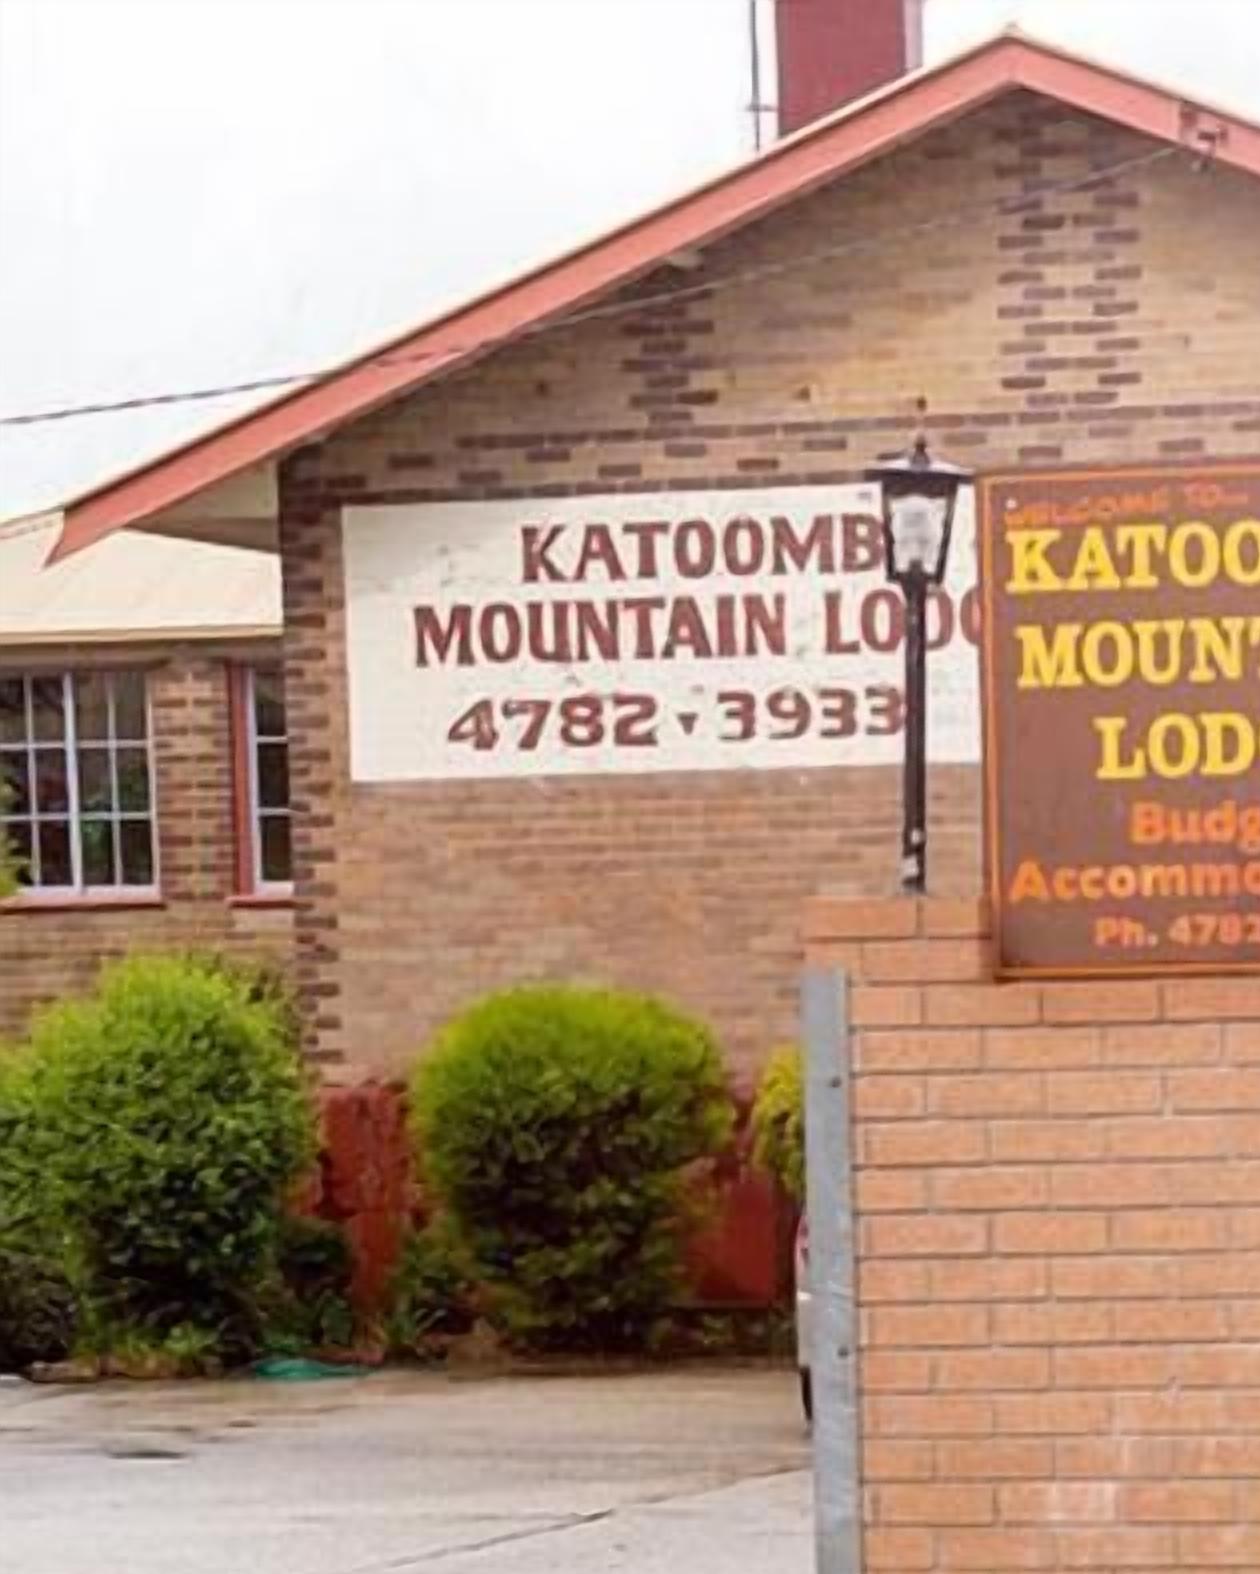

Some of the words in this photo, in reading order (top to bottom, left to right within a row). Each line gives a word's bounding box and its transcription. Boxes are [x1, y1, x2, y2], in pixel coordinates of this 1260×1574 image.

[520, 513, 884, 584] KATOOMB
[413, 591, 787, 667] MOUNTAIN
[447, 692, 659, 750] 4782
[716, 686, 906, 741] 3933
